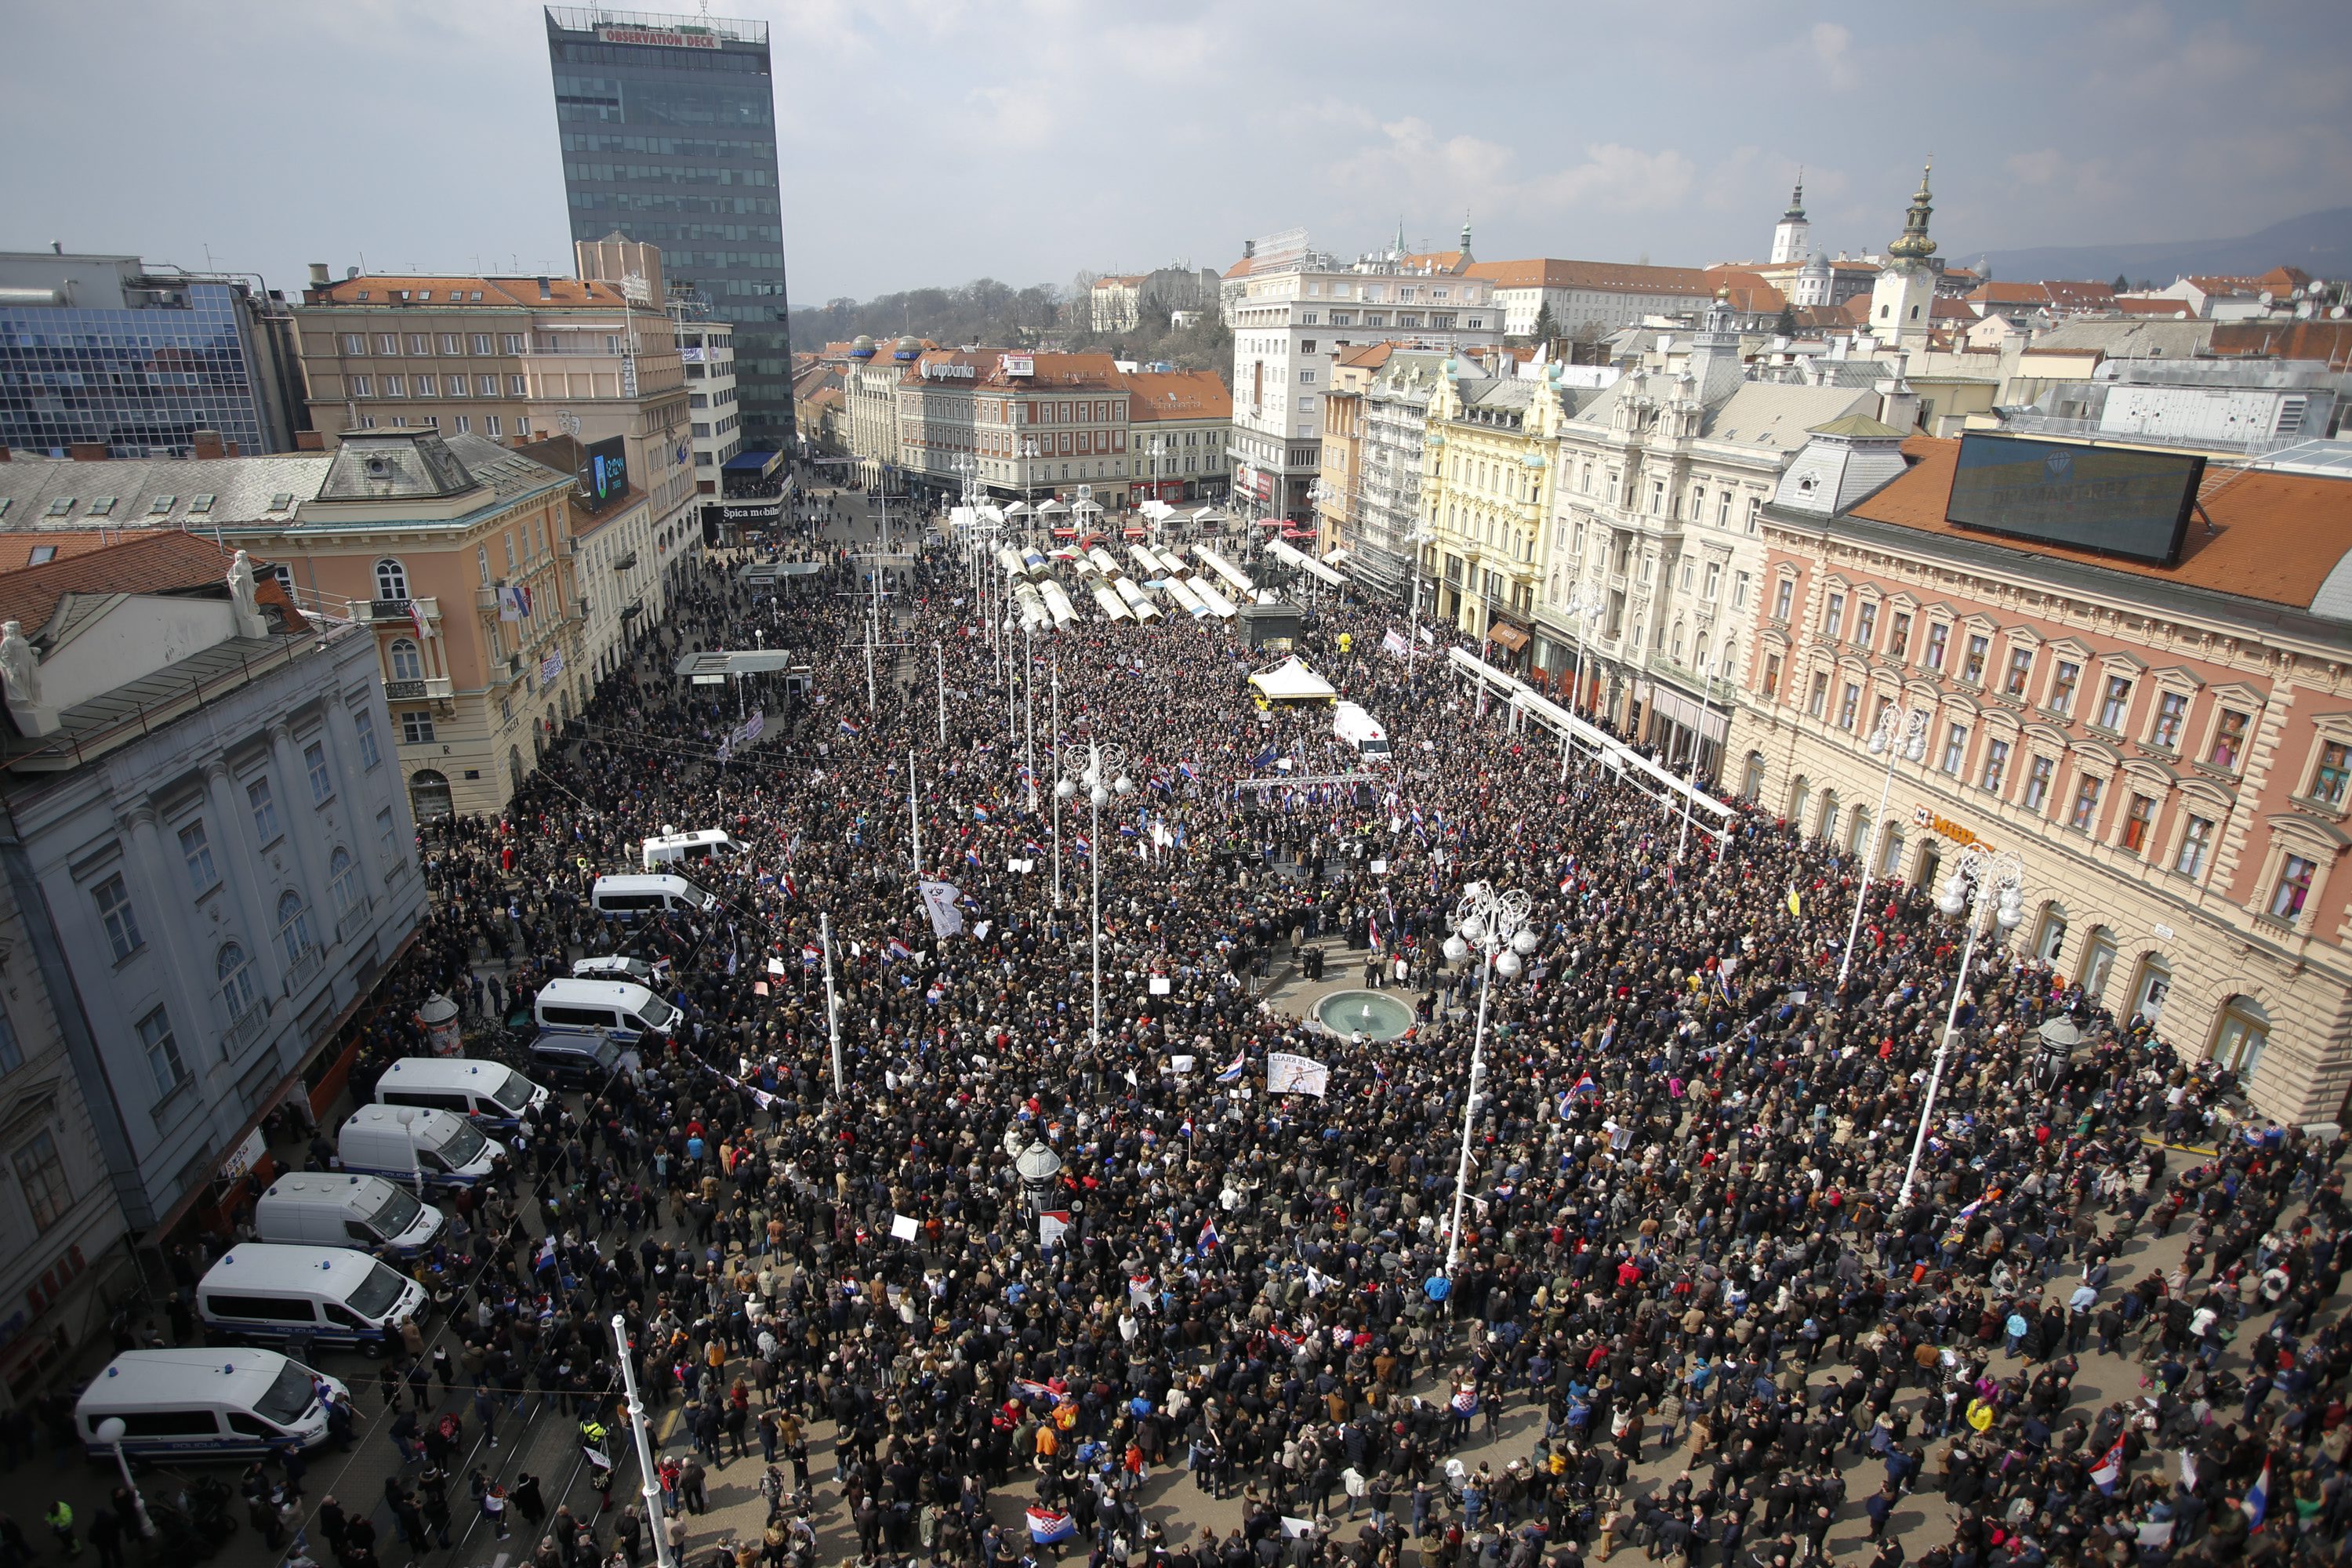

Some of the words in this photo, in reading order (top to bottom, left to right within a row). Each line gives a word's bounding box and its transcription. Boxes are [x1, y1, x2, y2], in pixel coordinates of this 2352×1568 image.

[606, 30, 683, 46] OBSERVATION
[686, 34, 715, 48] DECK
[724, 506, 749, 519] Špica
[503, 717, 519, 739] SINGER
[423, 1217, 443, 1241] POLICIJA
[276, 1326, 318, 1334] POLICIJA
[172, 1440, 221, 1449] POLICIJA
